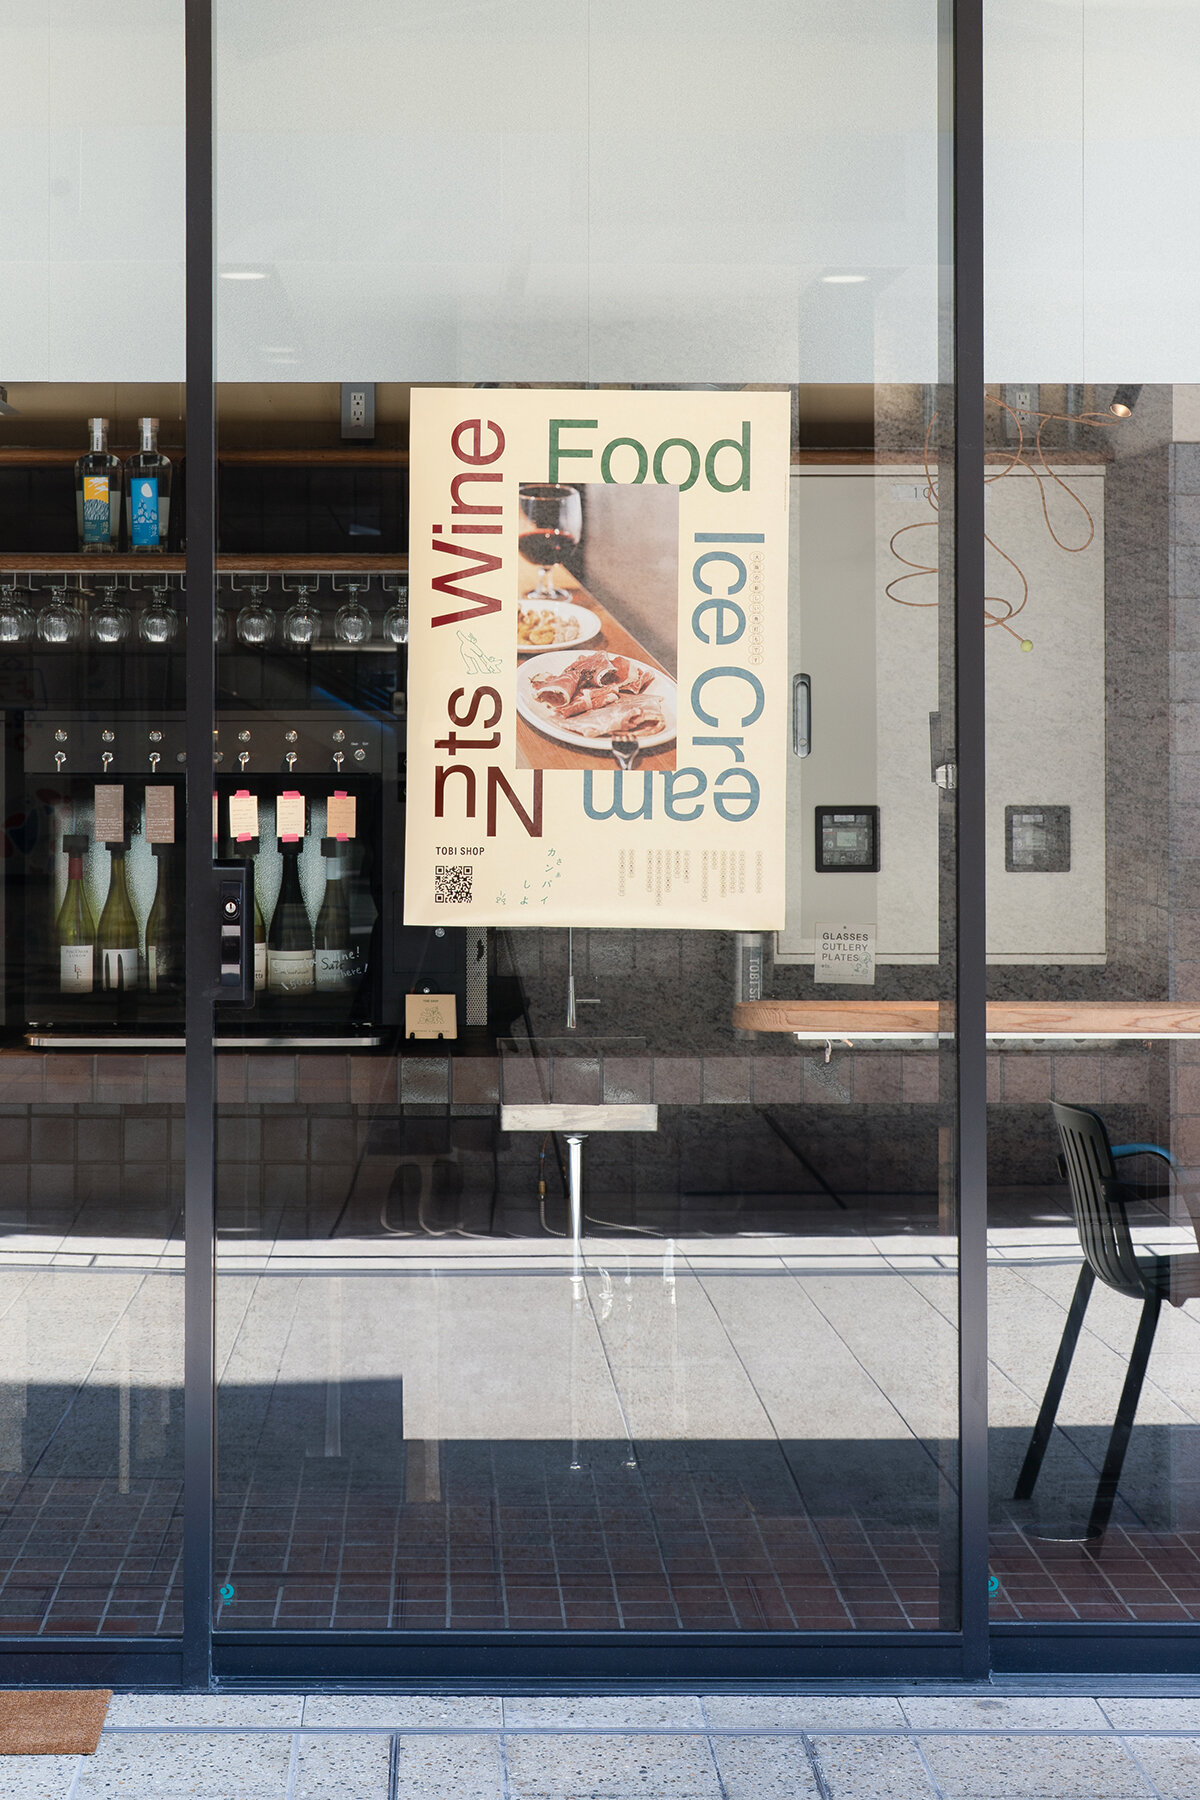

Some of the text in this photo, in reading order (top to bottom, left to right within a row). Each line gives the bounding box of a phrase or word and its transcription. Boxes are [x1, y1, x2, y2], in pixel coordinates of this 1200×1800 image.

[548, 419, 751, 493] Food
[904, 486, 939, 499] 10
[431, 418, 506, 628] Wine
[691, 532, 765, 645] Ice
[435, 846, 485, 856] TOBI SHOP
[822, 932, 869, 941] GLASSES
[822, 943, 868, 951] CUTLERY
[821, 953, 859, 962] PLATES
